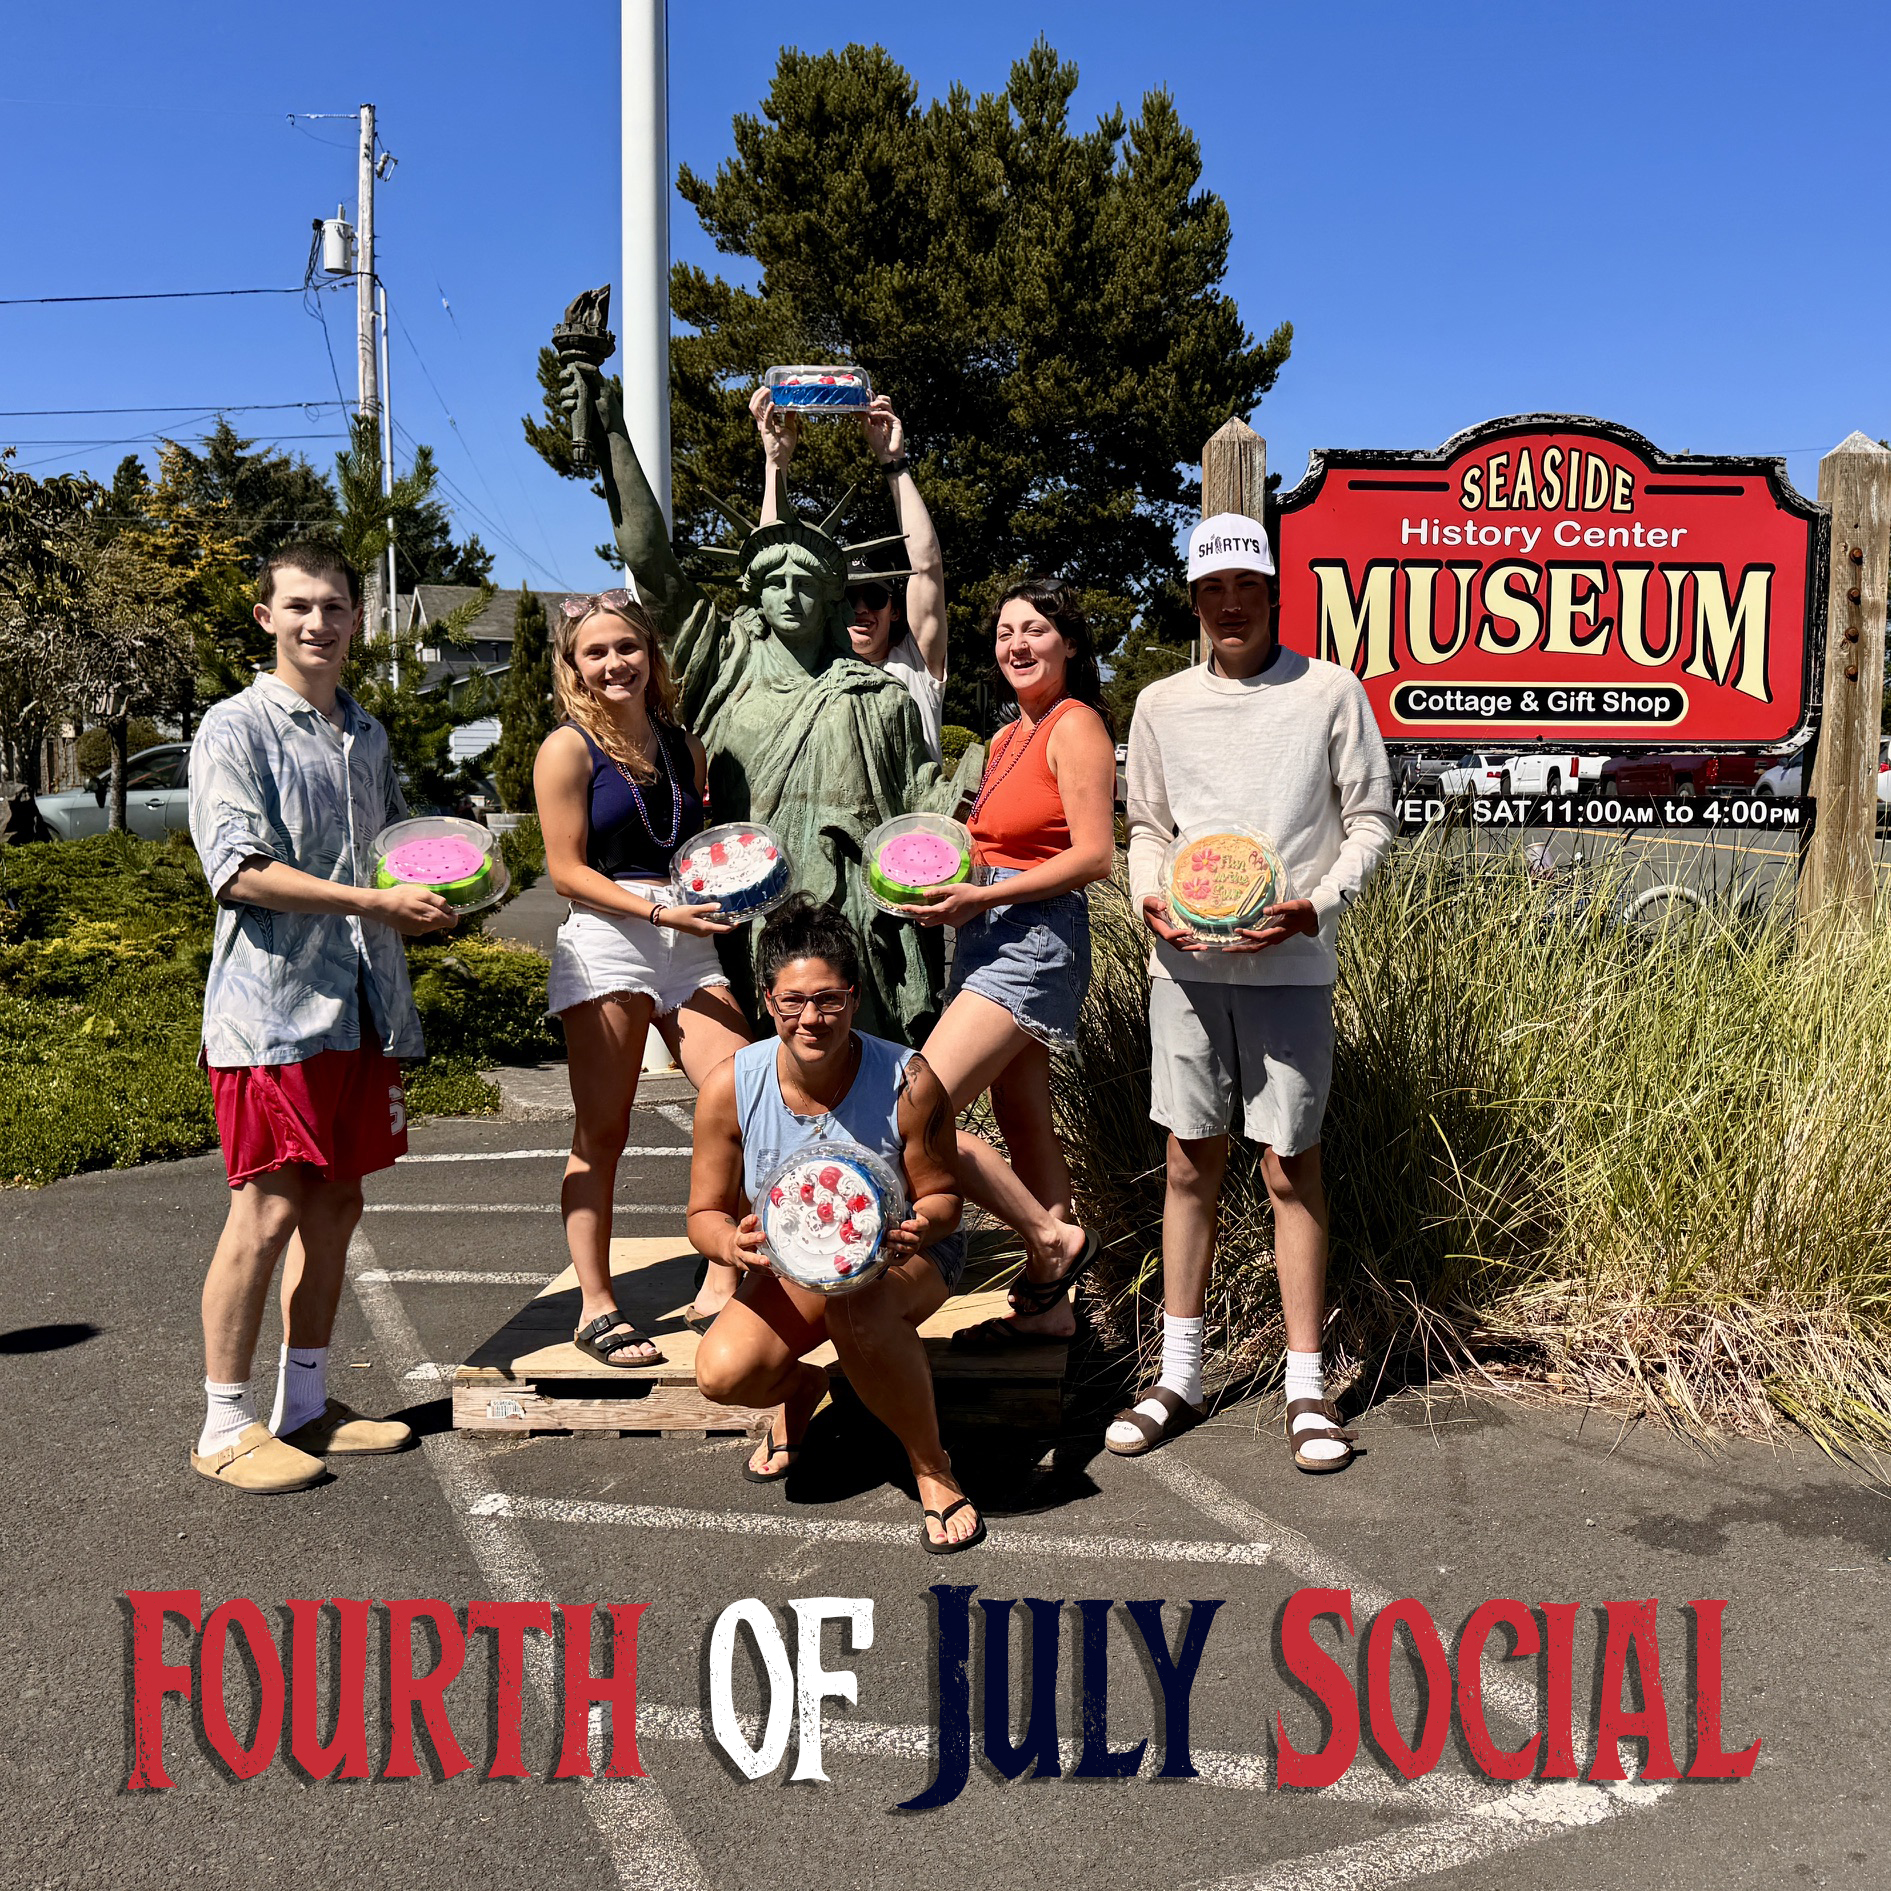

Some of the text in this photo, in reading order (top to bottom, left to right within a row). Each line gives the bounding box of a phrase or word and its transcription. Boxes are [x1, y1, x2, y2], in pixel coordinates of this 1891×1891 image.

[1460, 446, 1633, 512] SEASIDE
[1400, 518, 1688, 553] History Center
[1313, 564, 1773, 704] MUSEUM
[1407, 689, 1671, 718] Cottage & Gift Shop
[1472, 799, 1533, 823] SAT
[1664, 800, 1694, 823] to
[1702, 800, 1800, 824] 4:00PM
